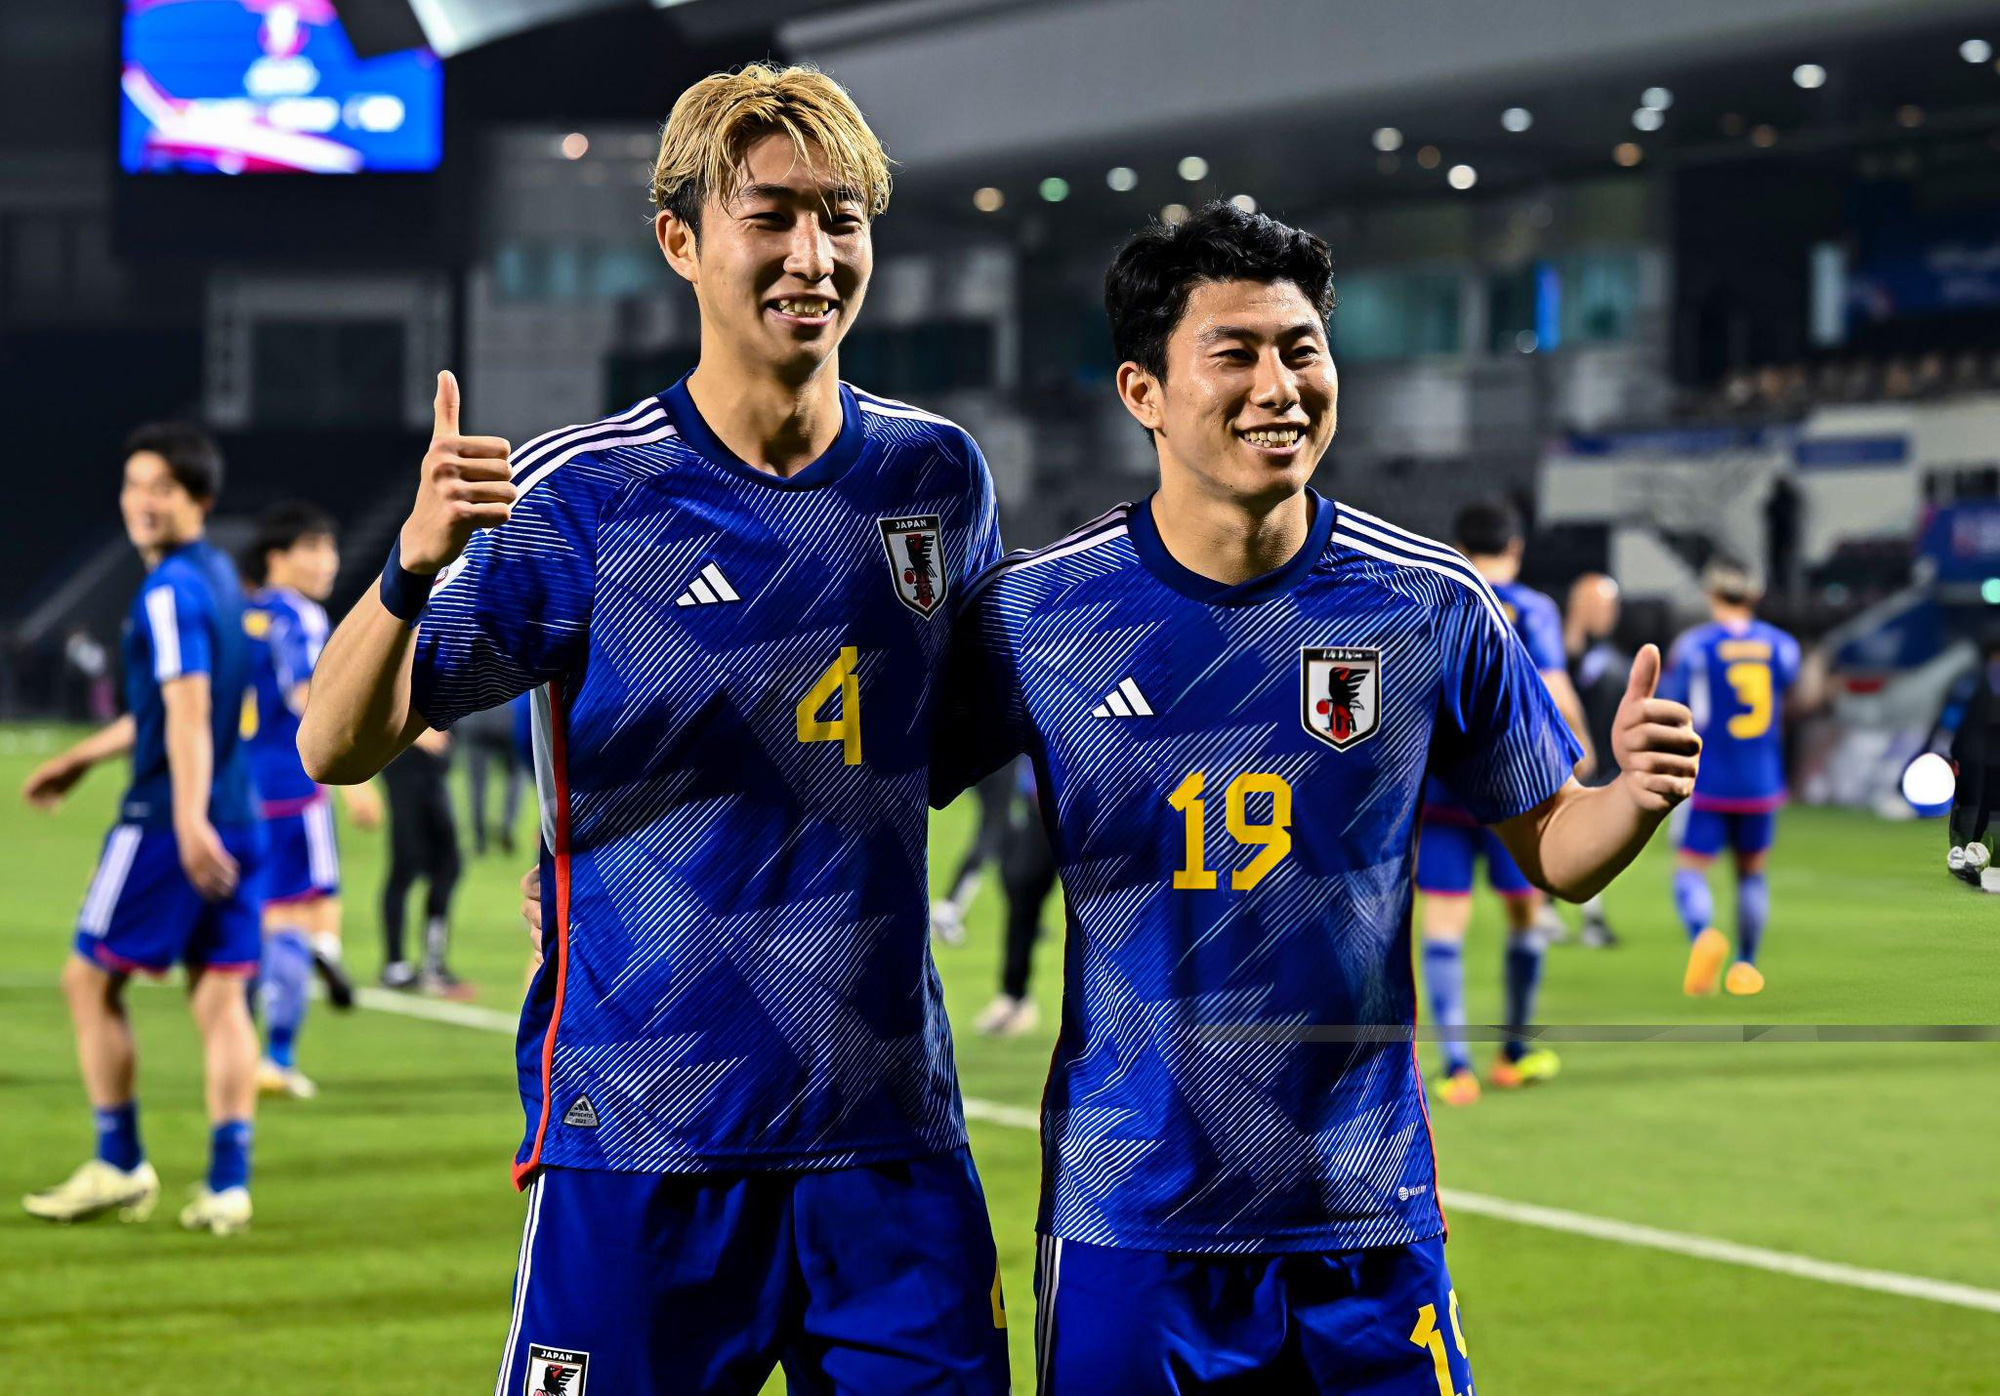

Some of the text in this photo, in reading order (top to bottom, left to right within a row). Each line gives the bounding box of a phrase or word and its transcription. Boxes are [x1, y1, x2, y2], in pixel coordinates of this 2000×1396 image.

[895, 519, 927, 529] JAPAN
[796, 646, 862, 766] 4
[1726, 662, 1773, 739] 3
[1167, 769, 1292, 892] 19
[541, 1350, 573, 1361] JAPAN
